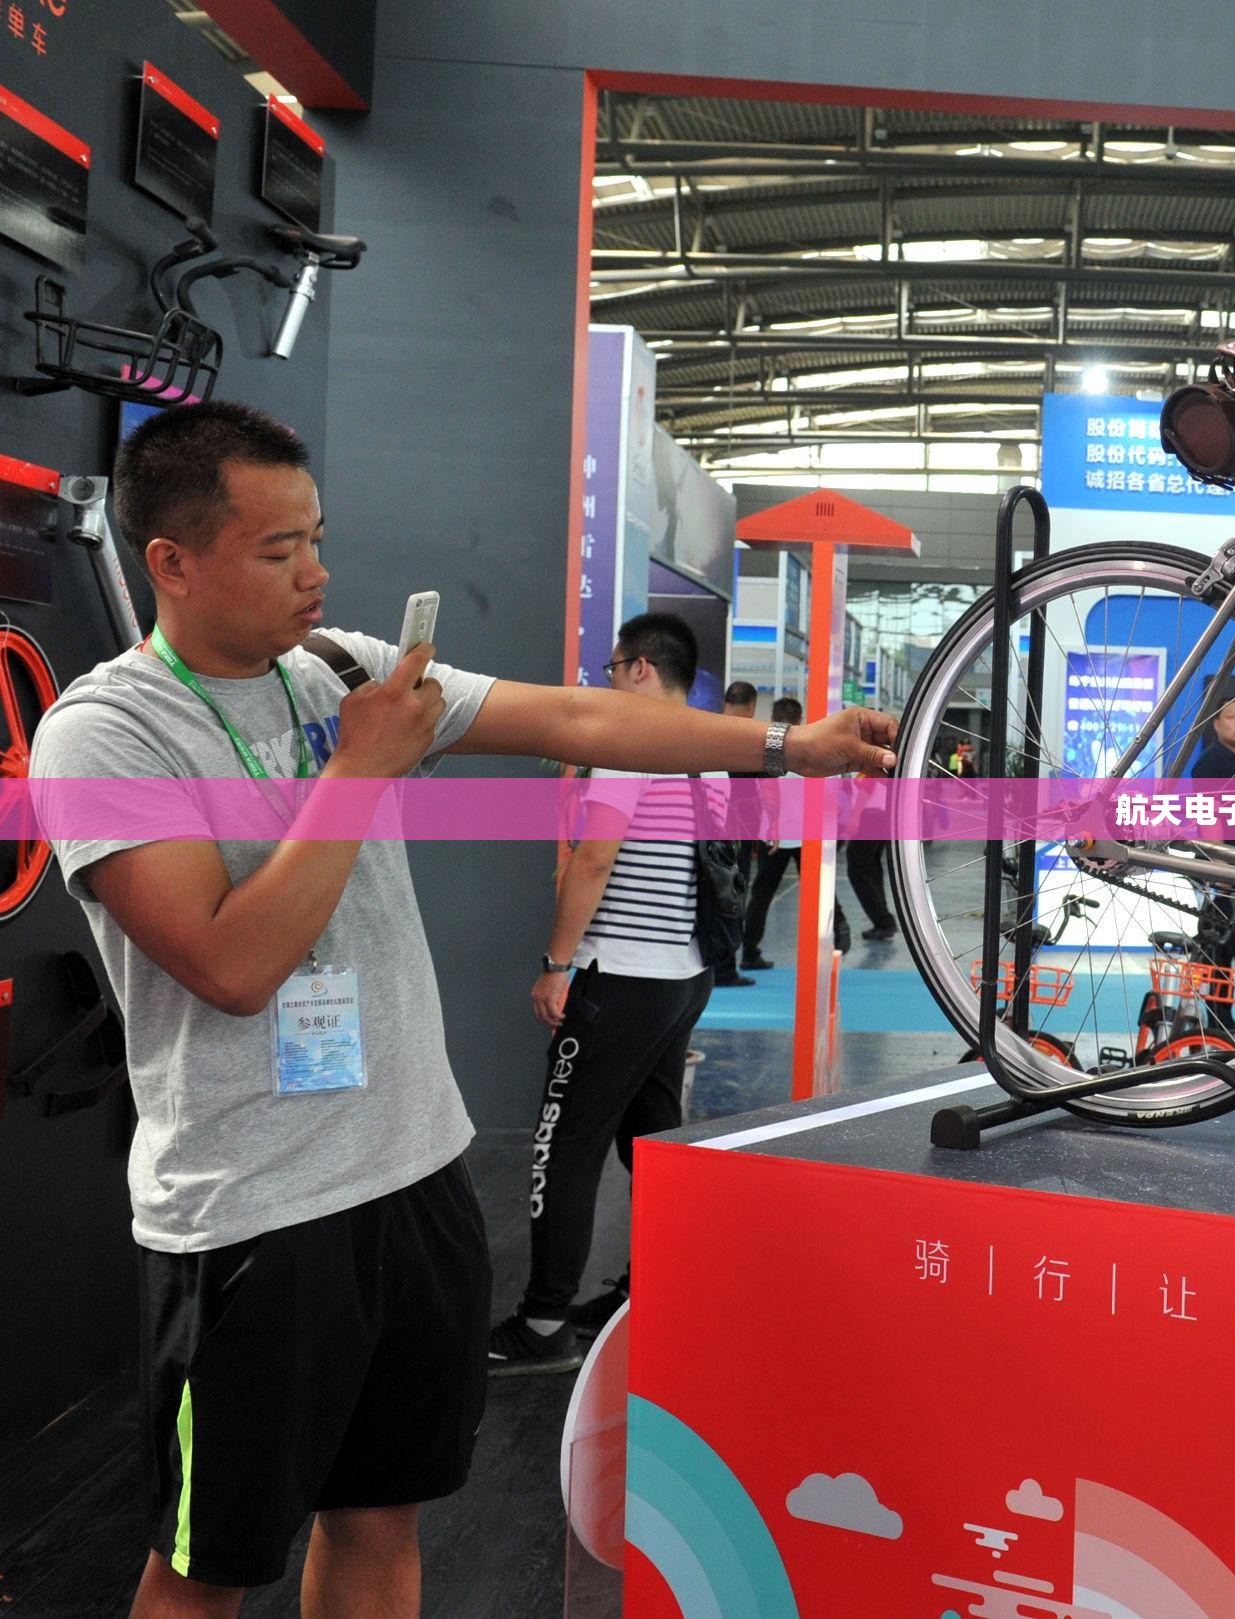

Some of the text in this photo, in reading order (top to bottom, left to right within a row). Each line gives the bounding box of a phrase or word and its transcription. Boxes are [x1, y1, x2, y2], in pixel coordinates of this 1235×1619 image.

[298, 1014, 341, 1031] 参观证
[530, 1037, 580, 1219] adidas neo
